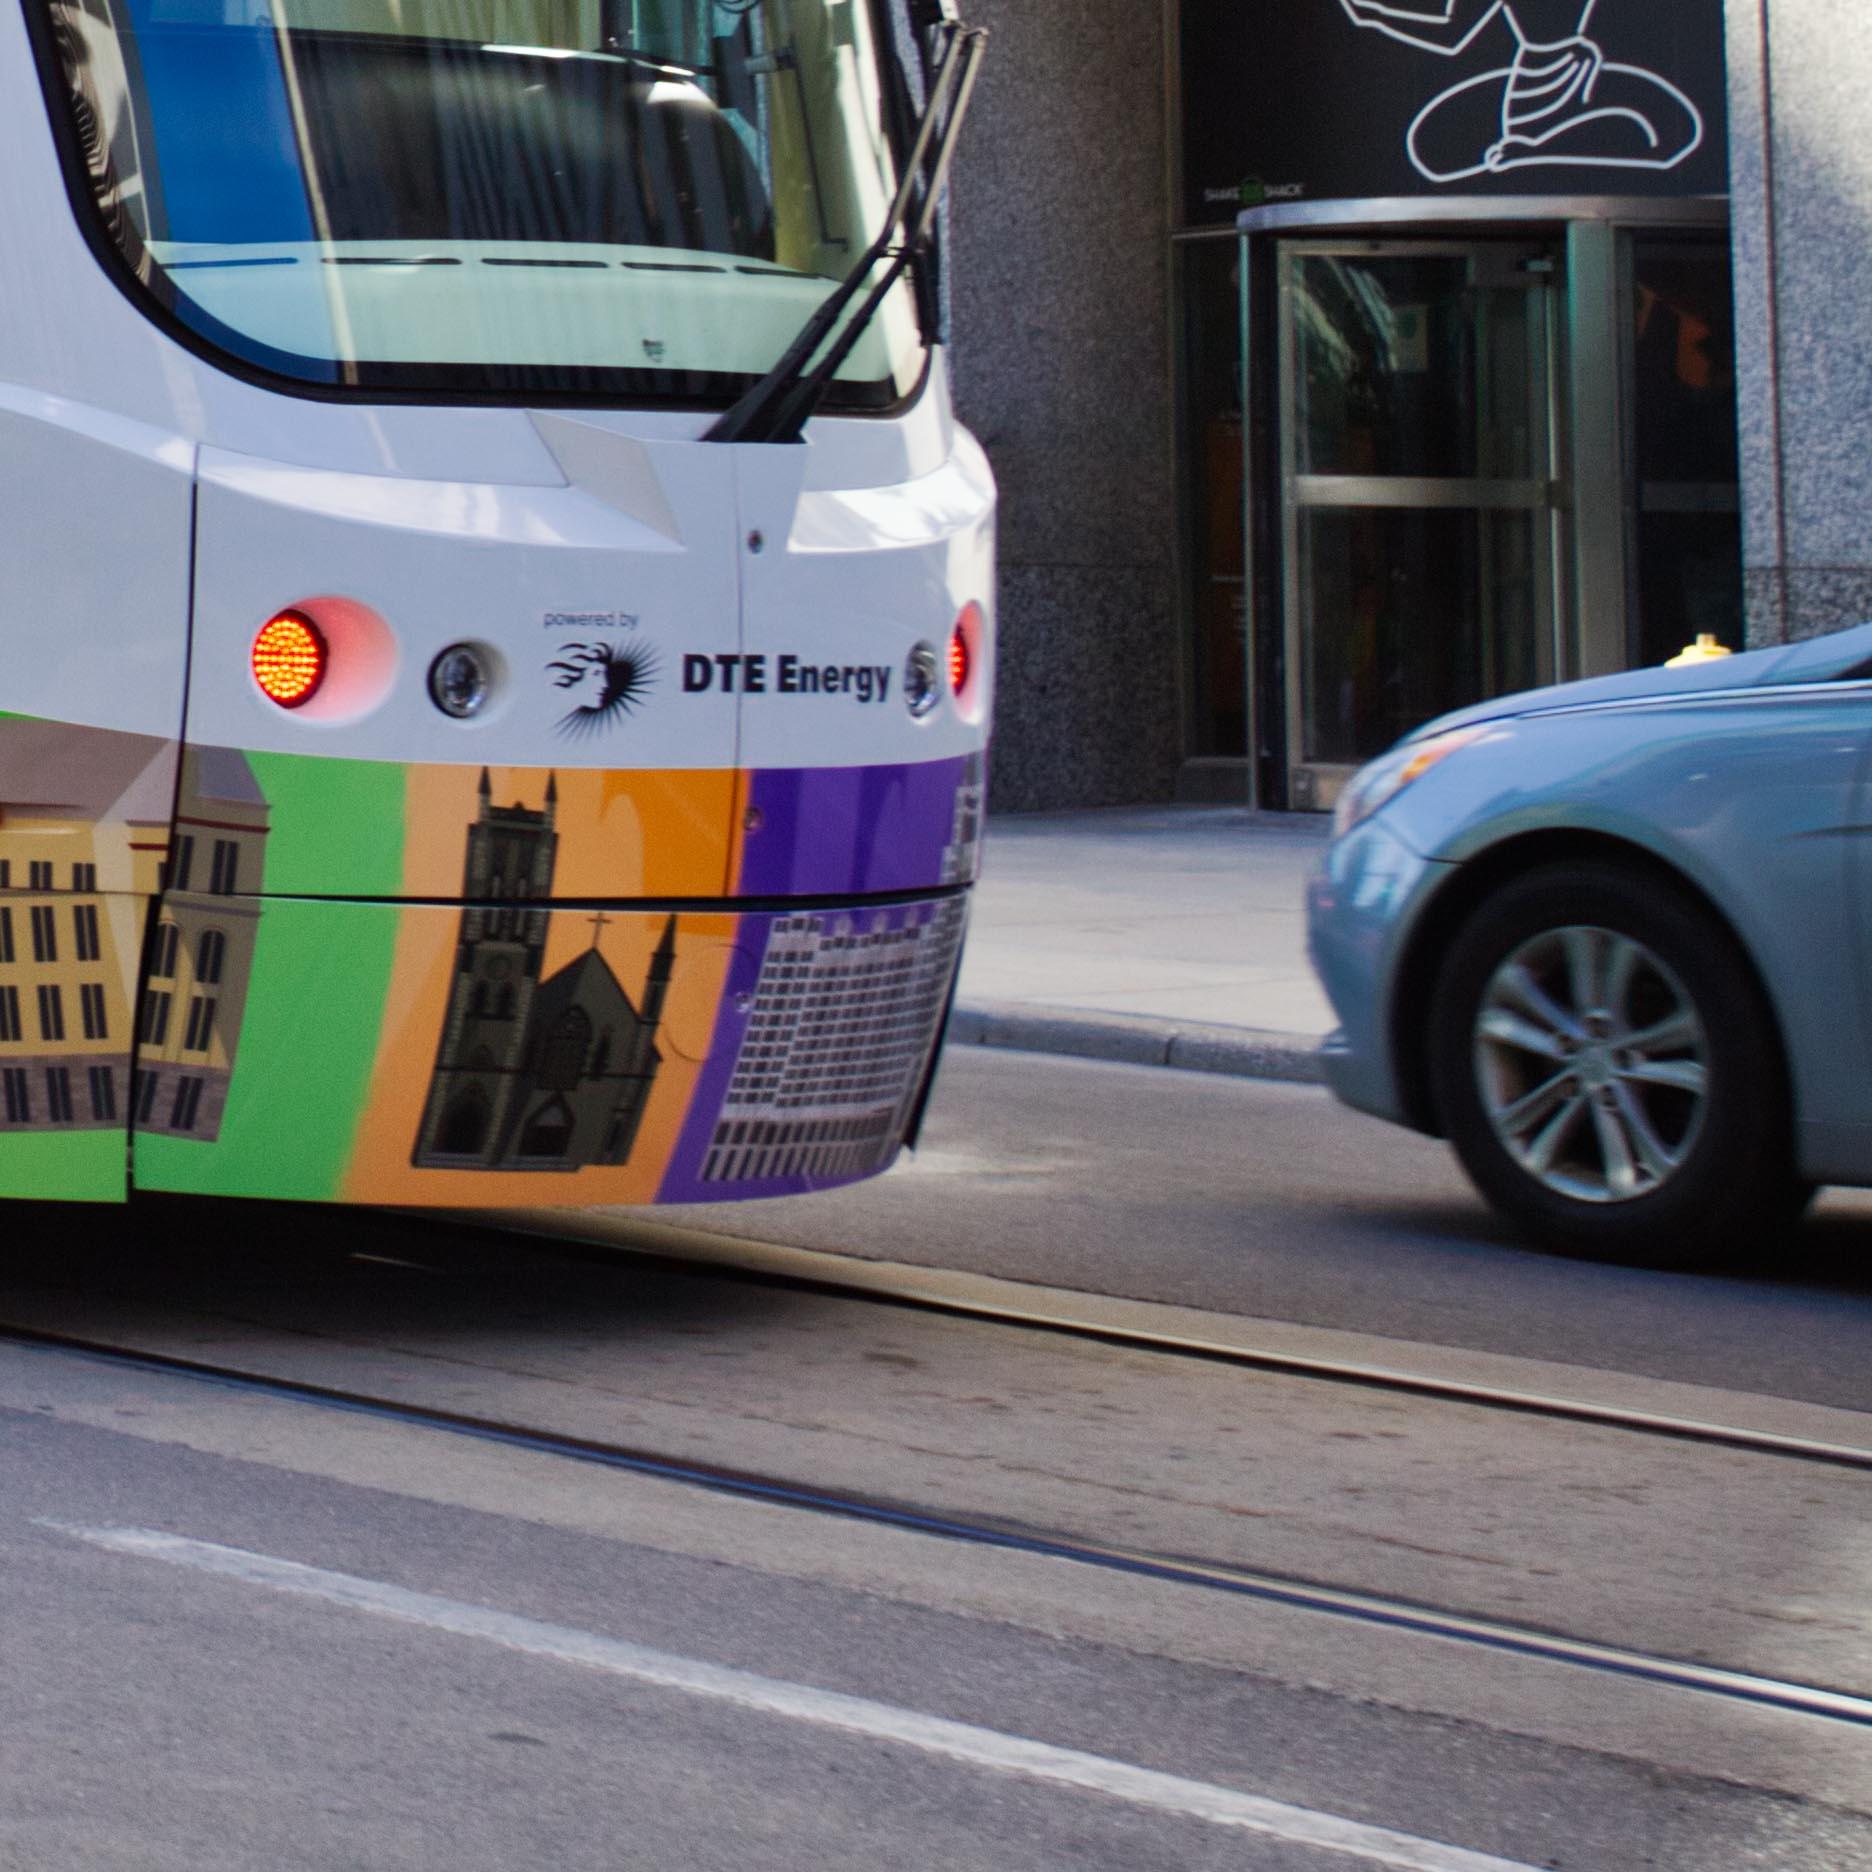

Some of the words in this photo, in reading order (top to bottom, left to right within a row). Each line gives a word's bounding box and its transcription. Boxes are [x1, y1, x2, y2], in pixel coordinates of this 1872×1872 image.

[543, 611, 614, 630] powered
[618, 610, 640, 630] by
[682, 654, 766, 693] DTE
[777, 654, 892, 703] Energy
